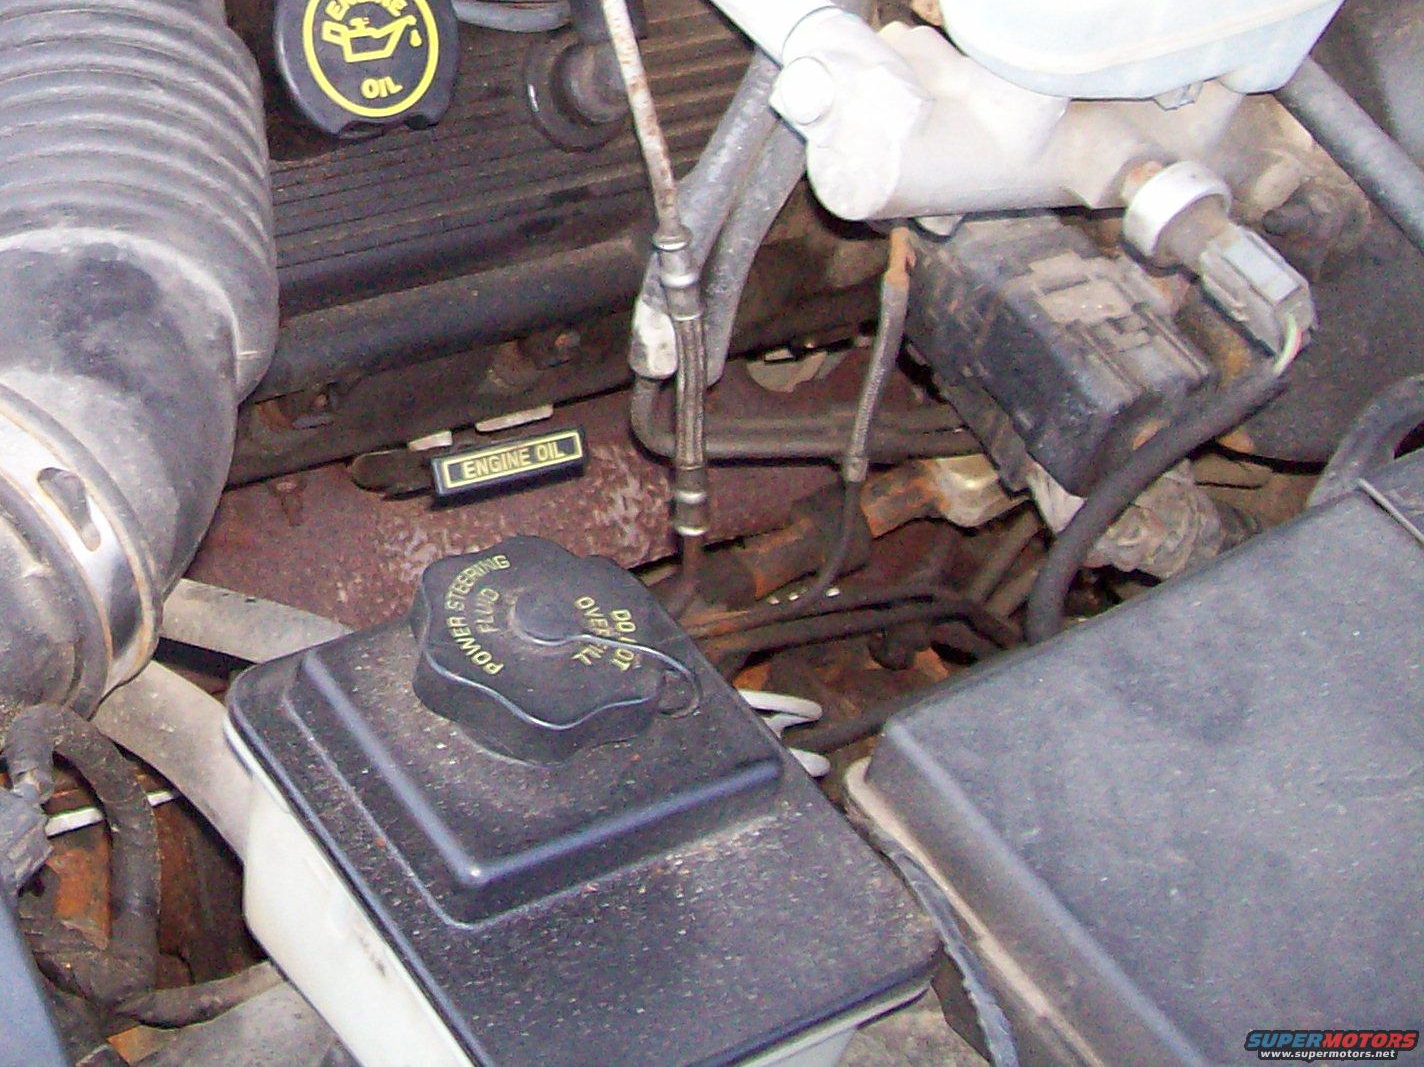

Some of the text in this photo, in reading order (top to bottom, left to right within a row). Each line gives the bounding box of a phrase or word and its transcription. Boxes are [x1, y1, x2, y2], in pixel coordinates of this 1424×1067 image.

[361, 76, 403, 100] OIL
[462, 441, 567, 479] ENGINE OIL
[445, 554, 511, 675] POWER STEERING
[572, 596, 610, 665] OVERILL
[609, 608, 636, 633] DO
